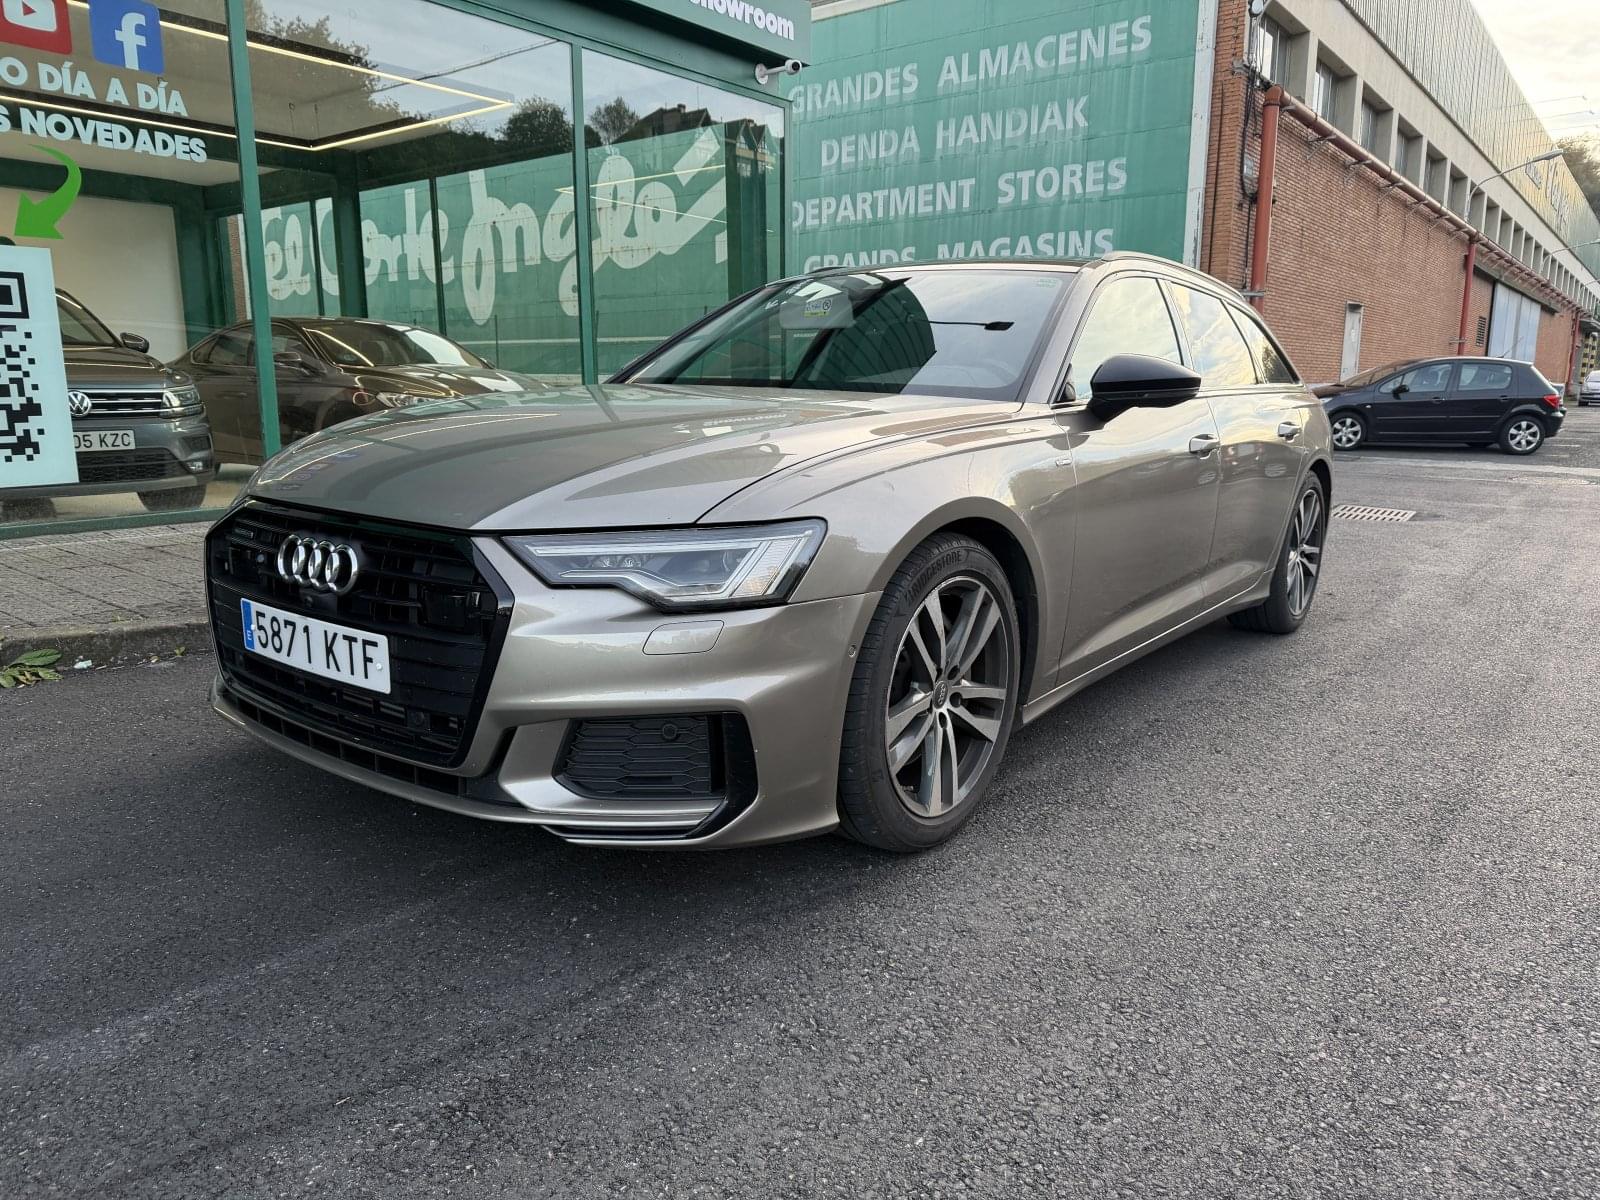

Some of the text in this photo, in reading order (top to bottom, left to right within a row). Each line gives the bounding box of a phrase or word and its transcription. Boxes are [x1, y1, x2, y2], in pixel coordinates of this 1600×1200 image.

[690, 0, 795, 41] owroom
[38, 61, 97, 100] DÍA
[105, 78, 130, 107] A
[137, 81, 189, 117] DÍA
[788, 15, 1152, 114] GRANDES ALMACENES
[20, 107, 208, 163] NOVEDADES
[821, 95, 1090, 168] DENDA HANDIAK
[792, 156, 1128, 228] DEPARTMENT STORES
[803, 228, 1115, 275] GRANDS MAGASINS
[98, 432, 132, 448] KZC
[255, 610, 312, 665] 5871
[323, 629, 379, 680] KTF
